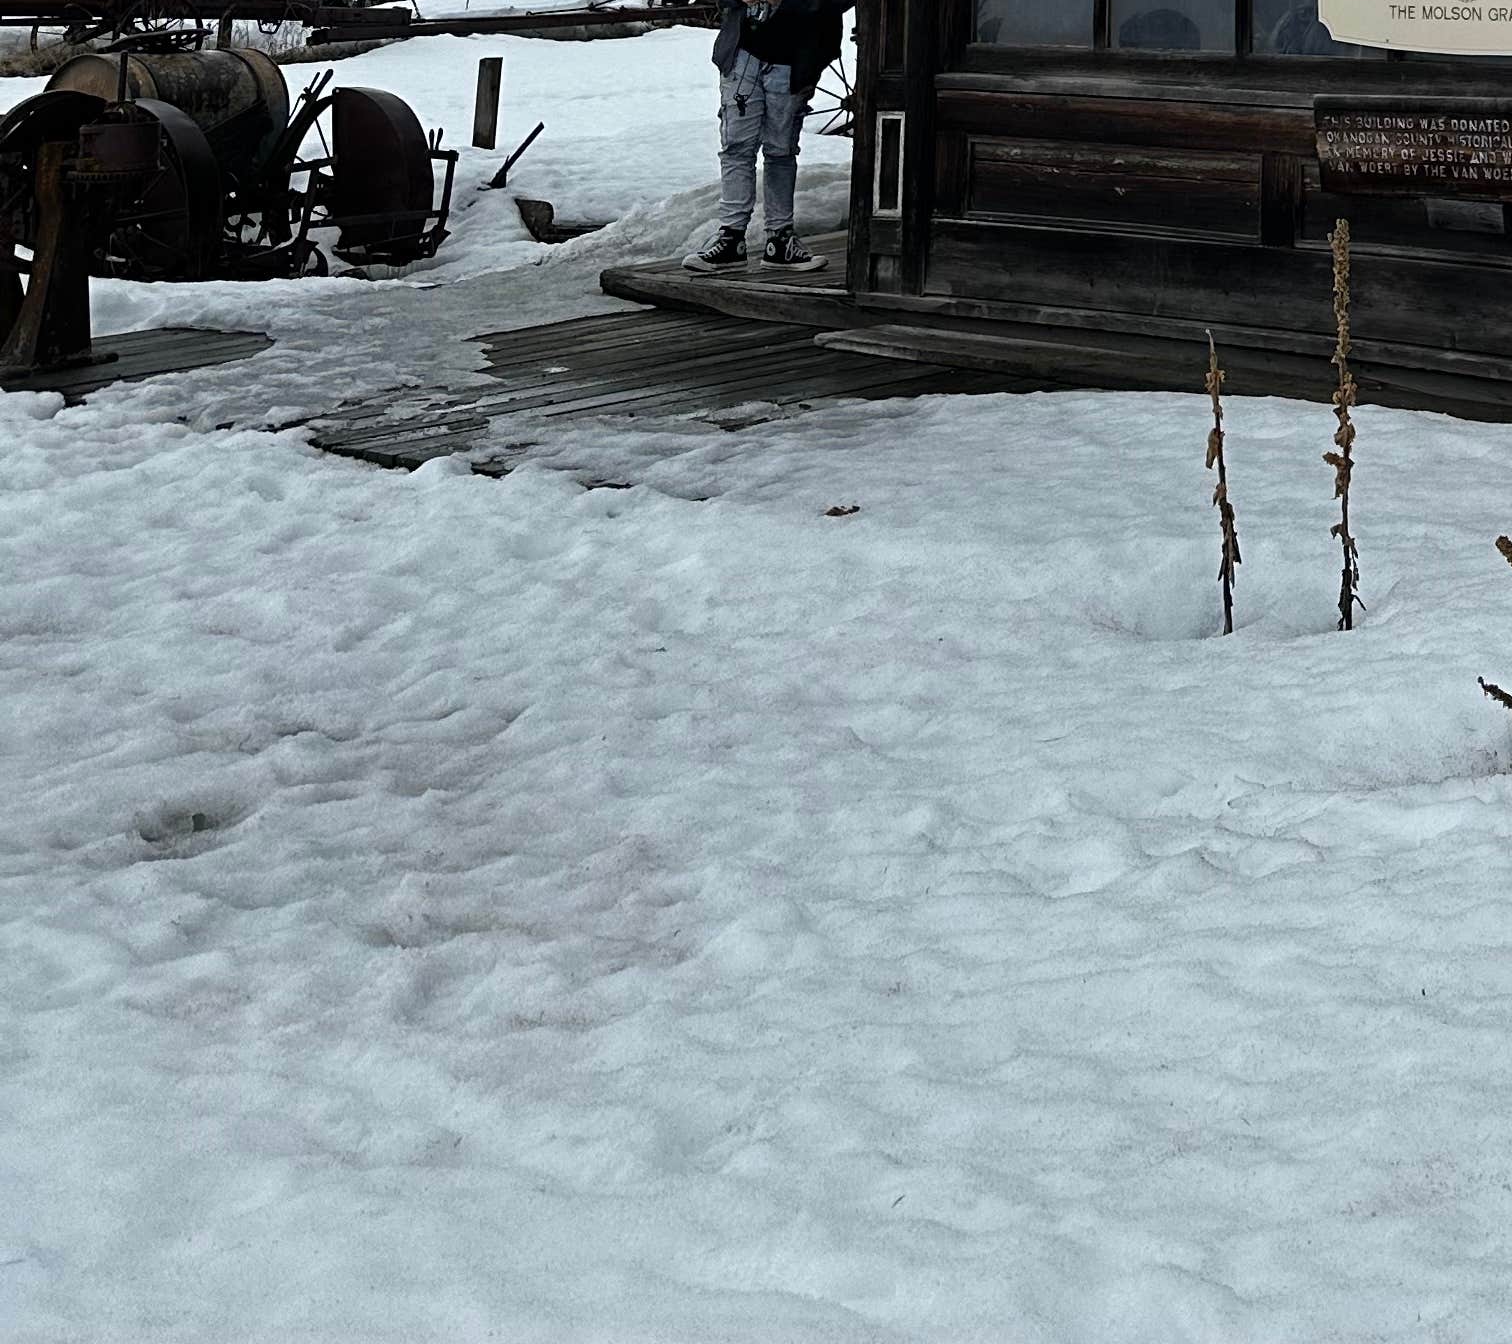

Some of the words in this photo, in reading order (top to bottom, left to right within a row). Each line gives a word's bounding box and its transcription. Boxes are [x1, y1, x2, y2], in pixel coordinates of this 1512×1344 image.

[1389, 5, 1416, 20] THE
[1422, 5, 1482, 21] MOLSON
[1356, 117, 1415, 130] BUILDING
[1419, 118, 1446, 131] WAS
[1450, 119, 1511, 133] DONATED
[1327, 132, 1390, 145] OKANOGAN
[1396, 132, 1442, 146] COUNTY
[1401, 149, 1417, 161] OF
[1422, 149, 1466, 163] JESSIE
[1470, 151, 1498, 165] AND
[1360, 162, 1400, 175] WOERT
[1404, 164, 1419, 176] BY
[1424, 164, 1448, 178] THE
[1451, 166, 1478, 180] VAN
